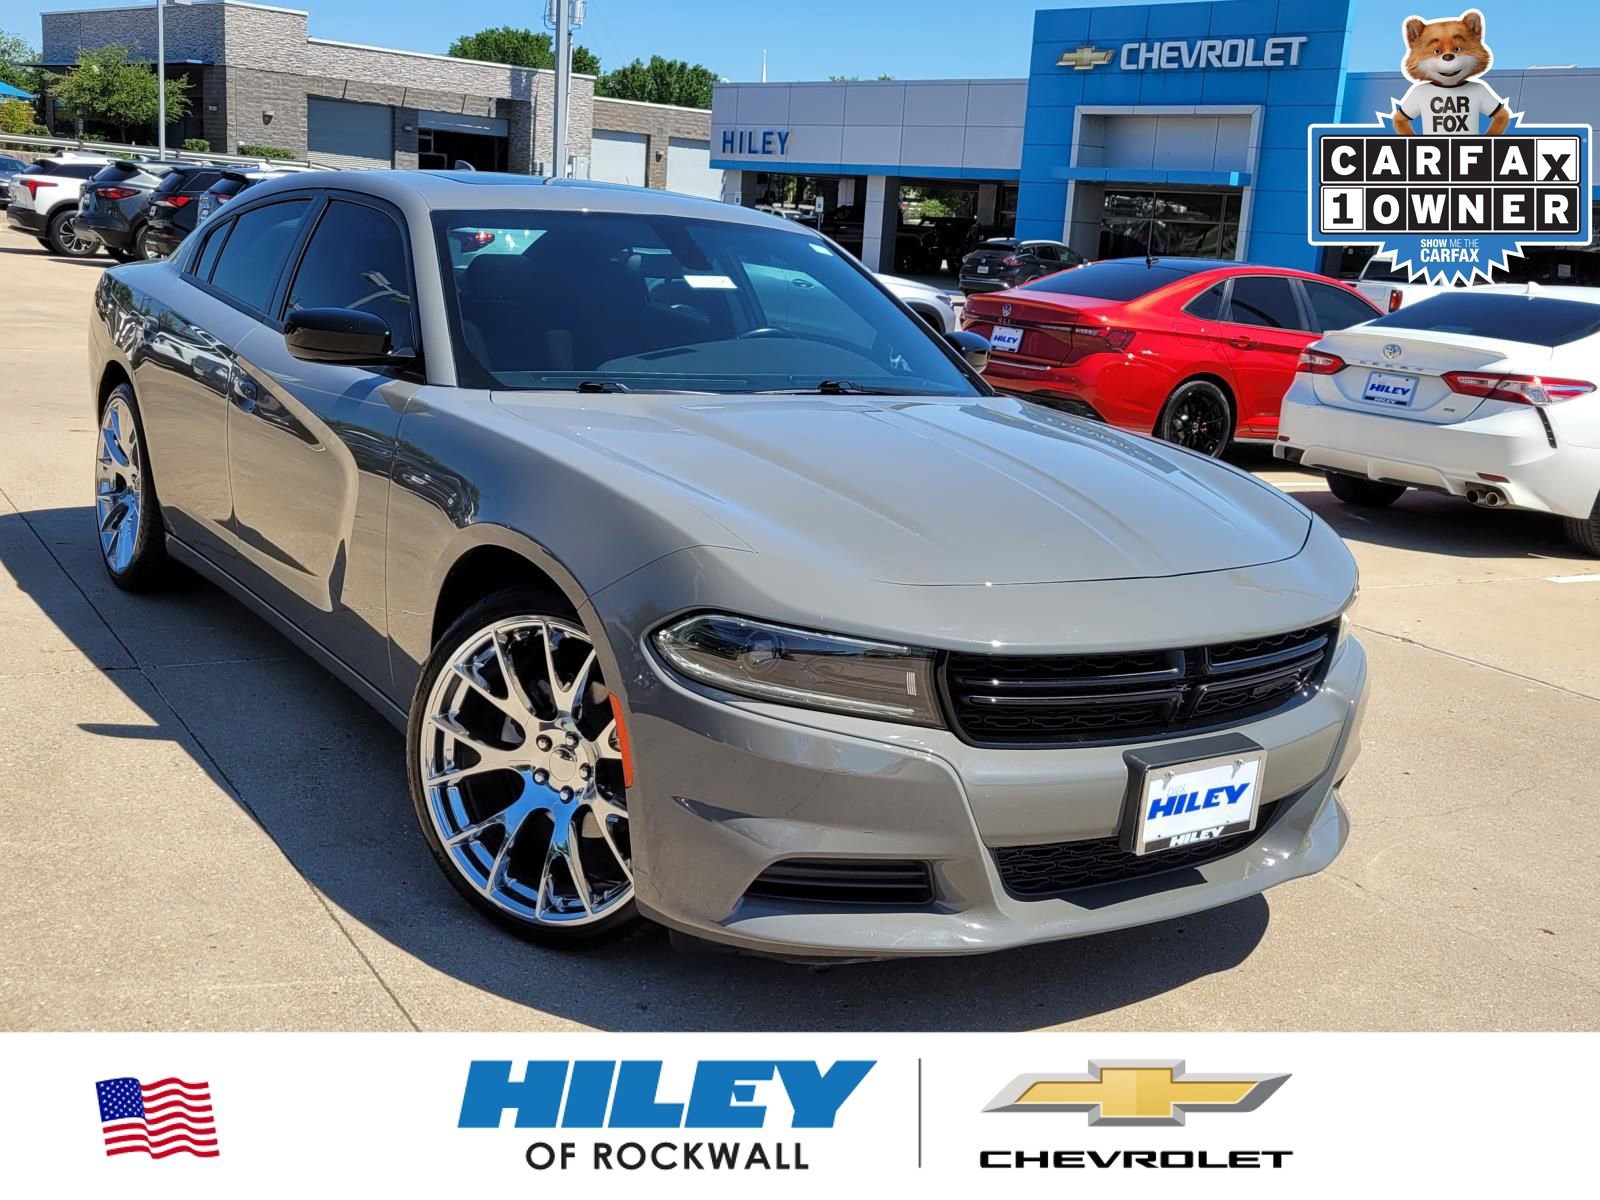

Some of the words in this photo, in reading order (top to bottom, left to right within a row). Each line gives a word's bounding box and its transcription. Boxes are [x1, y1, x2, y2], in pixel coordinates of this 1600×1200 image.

[1120, 36, 1309, 70] CHEVROLET
[722, 131, 790, 155] HILEY
[993, 334, 1019, 344] HILEY
[1369, 383, 1411, 396] HILEY
[1147, 782, 1251, 821] HILEY
[1169, 825, 1226, 848] HILEY
